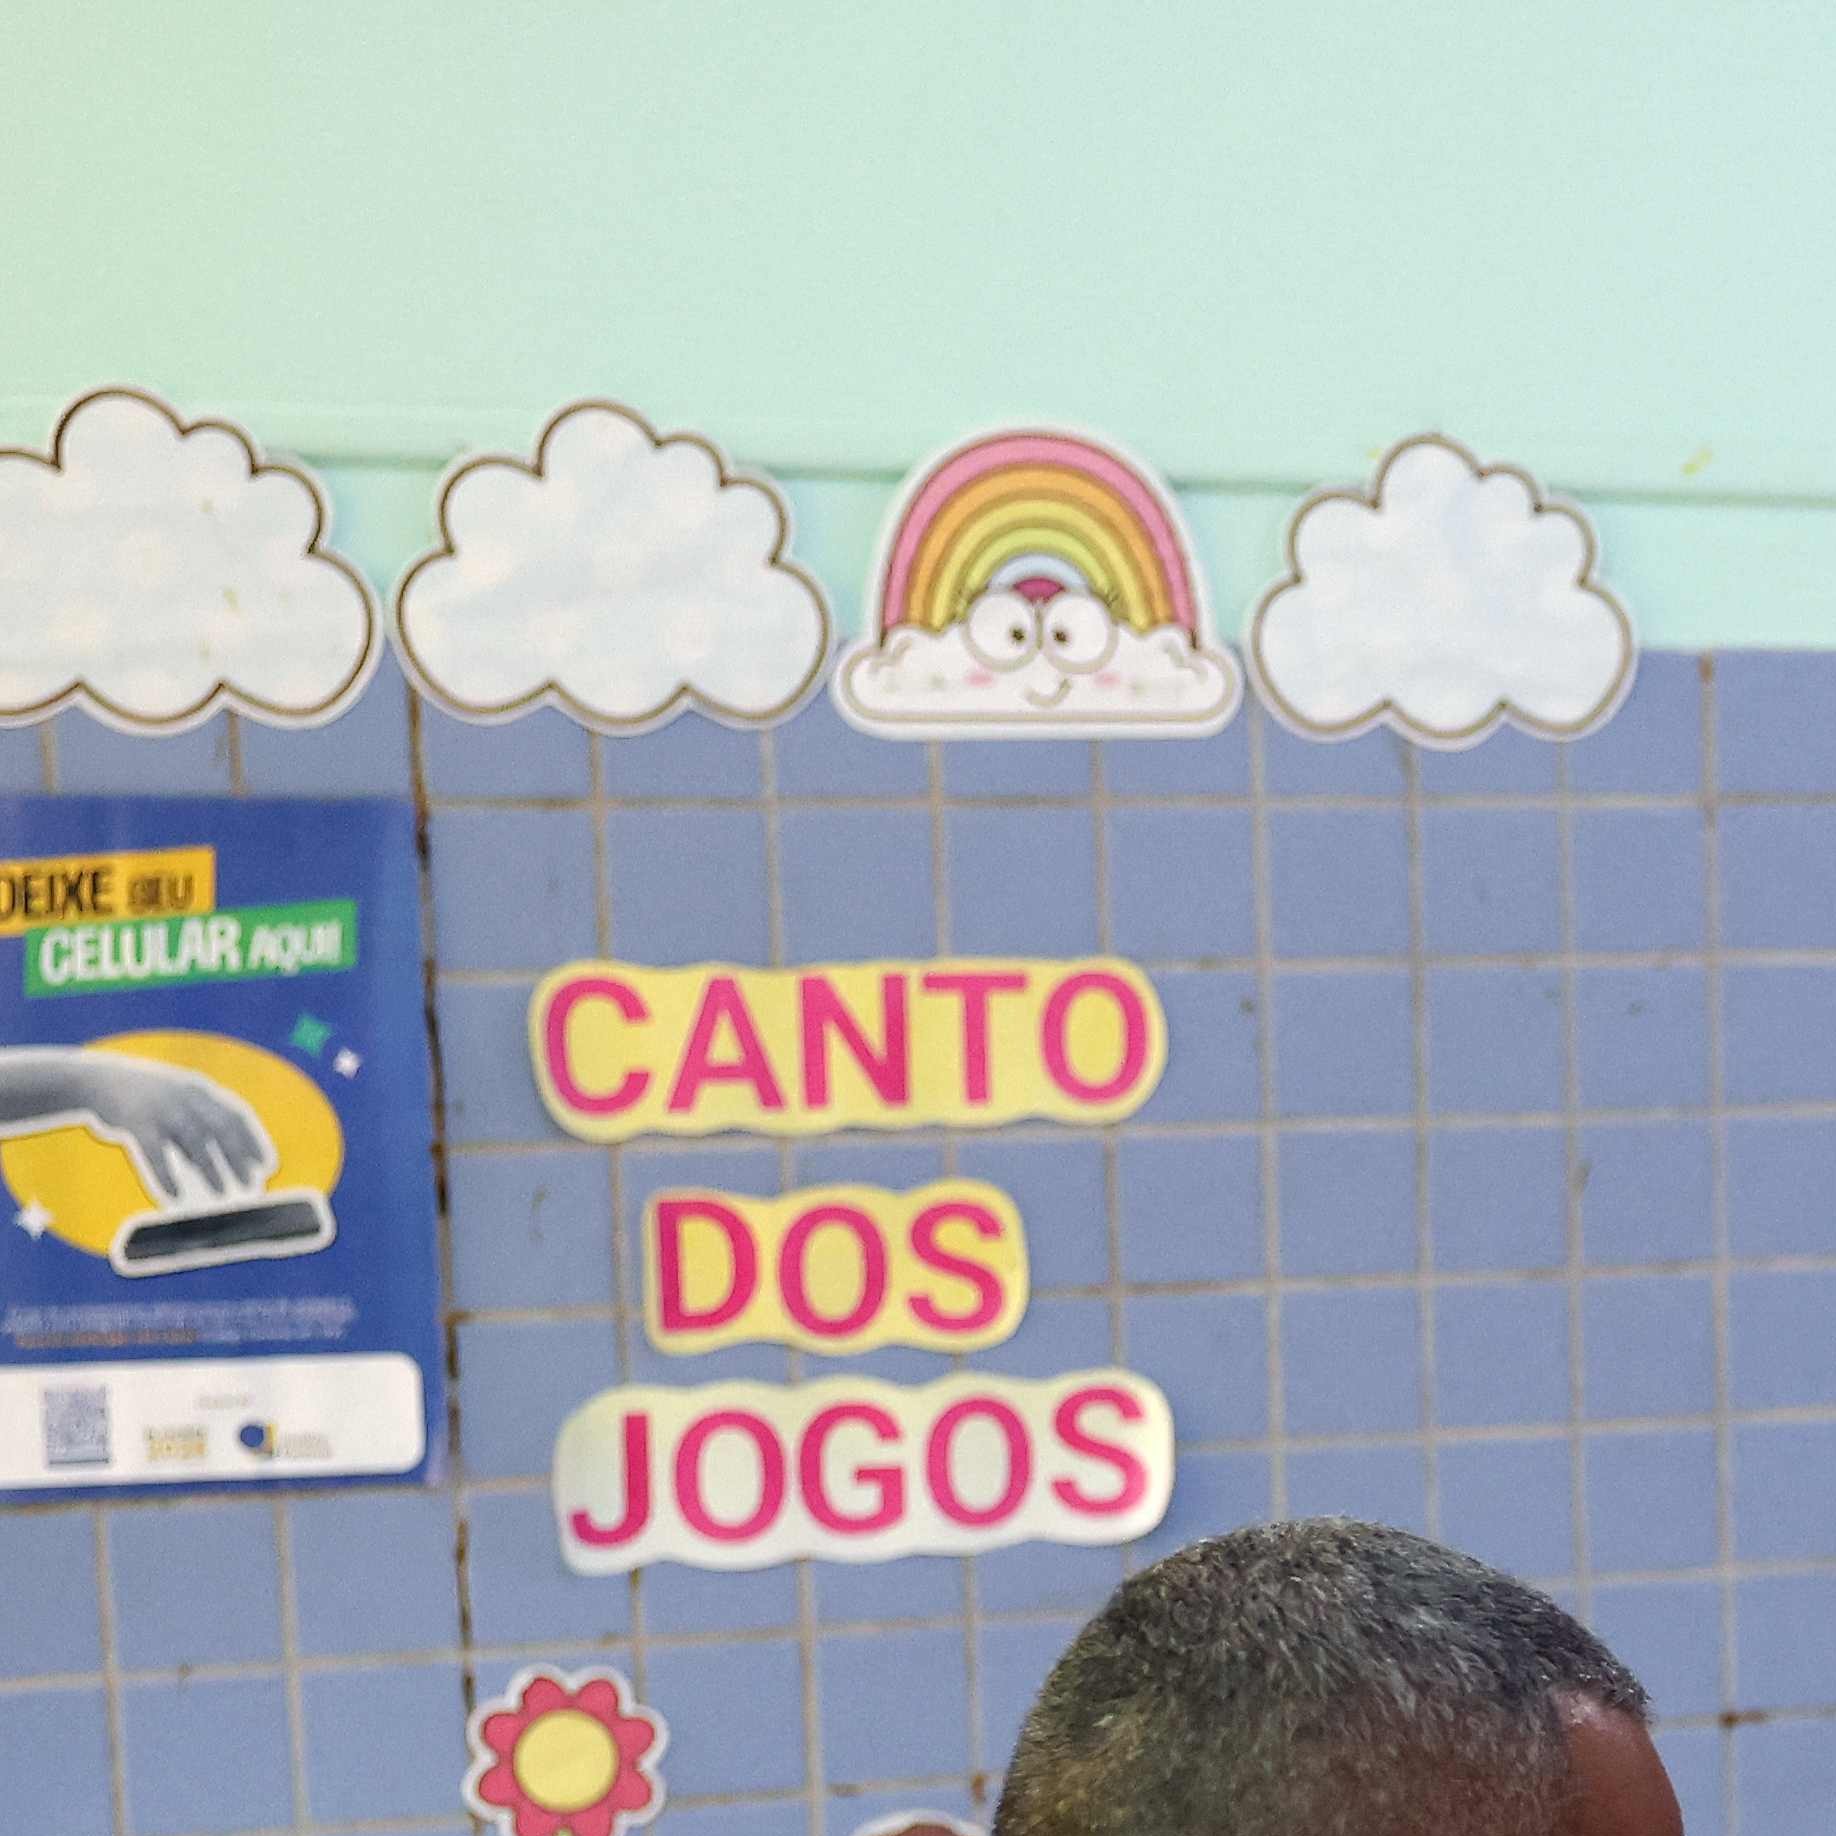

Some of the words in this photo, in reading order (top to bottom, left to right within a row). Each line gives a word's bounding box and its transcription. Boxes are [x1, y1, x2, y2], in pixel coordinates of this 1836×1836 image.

[39, 915, 241, 985] CELULAR
[545, 971, 1149, 1116] CANTO
[655, 1198, 1005, 1337] DOS
[568, 1385, 1149, 1550] JOGOS
